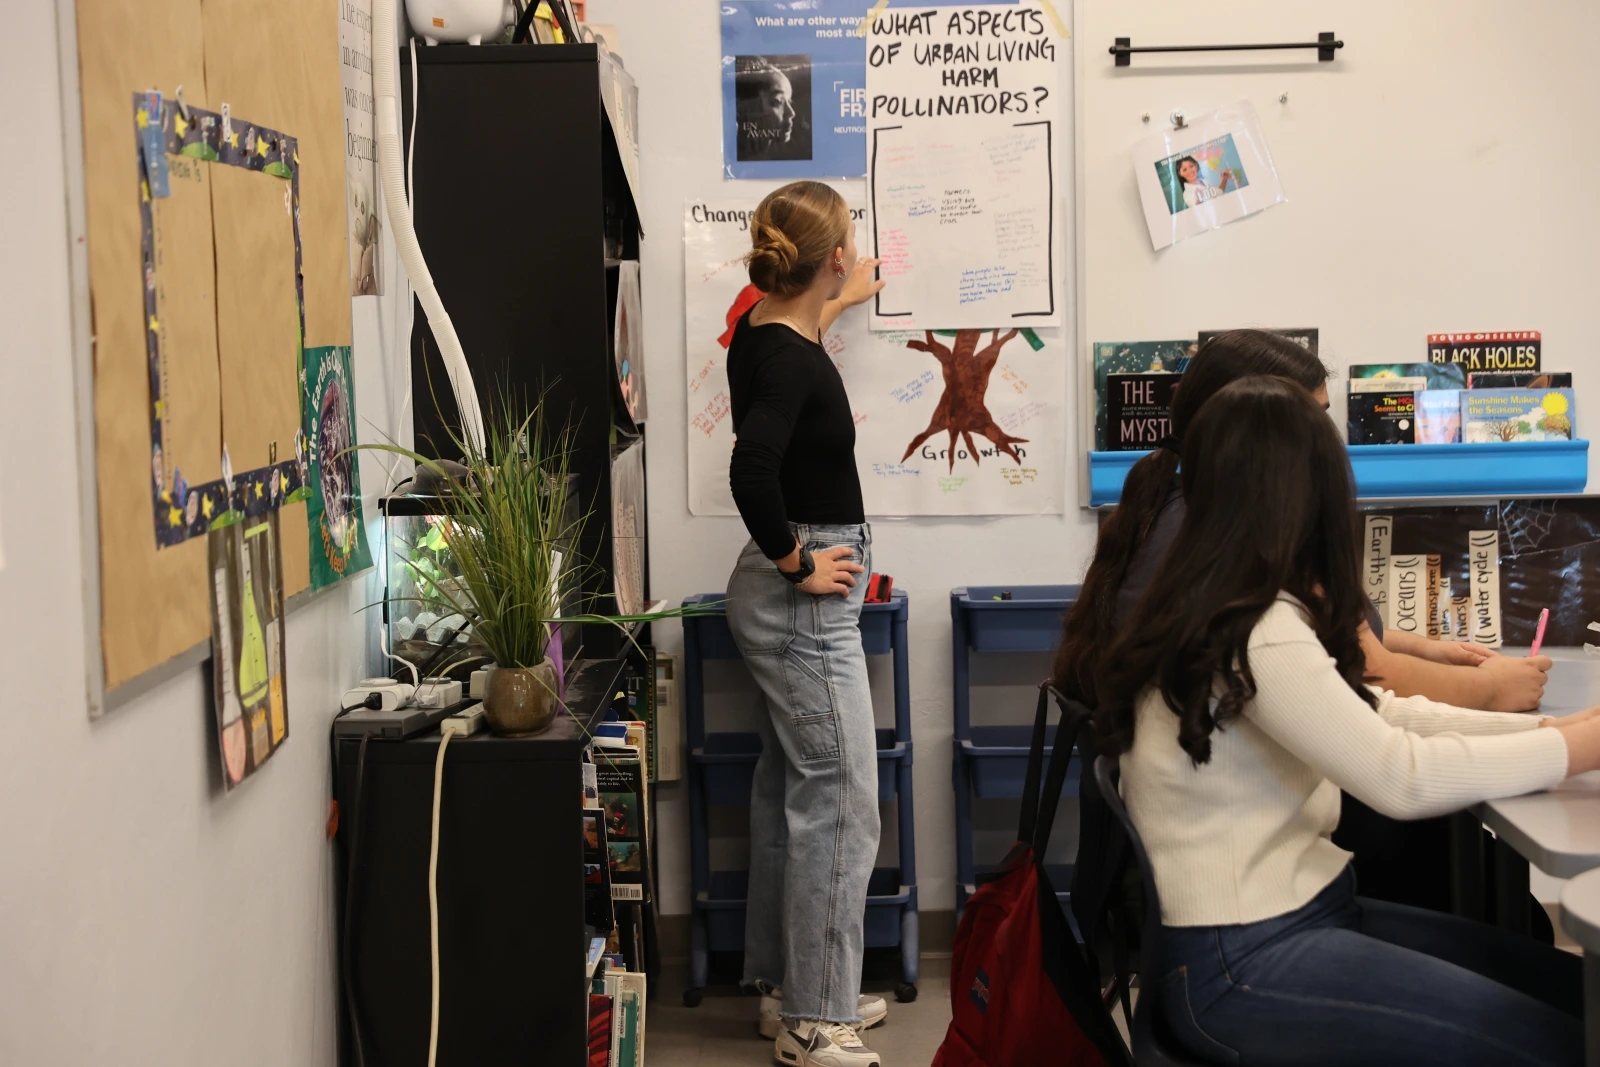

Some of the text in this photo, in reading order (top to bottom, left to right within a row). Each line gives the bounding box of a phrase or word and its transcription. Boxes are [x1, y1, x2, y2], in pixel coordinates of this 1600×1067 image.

[756, 16, 784, 26] What
[788, 18, 804, 26] are
[808, 16, 836, 26] other
[816, 28, 842, 38] most
[872, 9, 1044, 37] WHAT ASPECTS
[869, 38, 1055, 67] OF URBAN LIVING
[942, 67, 999, 88] HARM
[345, 86, 358, 110] was
[872, 86, 1048, 118] POLLINATORS?
[743, 122, 758, 130] EN
[747, 128, 780, 138] AVANT
[1485, 346, 1536, 369] HOLES
[312, 357, 327, 413] Earth
[1121, 381, 1155, 404] THE
[1469, 395, 1540, 405] Sunshine Makes
[1469, 406, 1524, 414] the Seasons
[309, 417, 318, 465] The
[320, 510, 330, 558] Let's
[330, 546, 343, 573] Keep
[1369, 526, 1387, 586] Earth's
[1397, 571, 1417, 632] Oceans
[1426, 569, 1439, 636] atmosphere
[1473, 552, 1493, 630] water cycle
